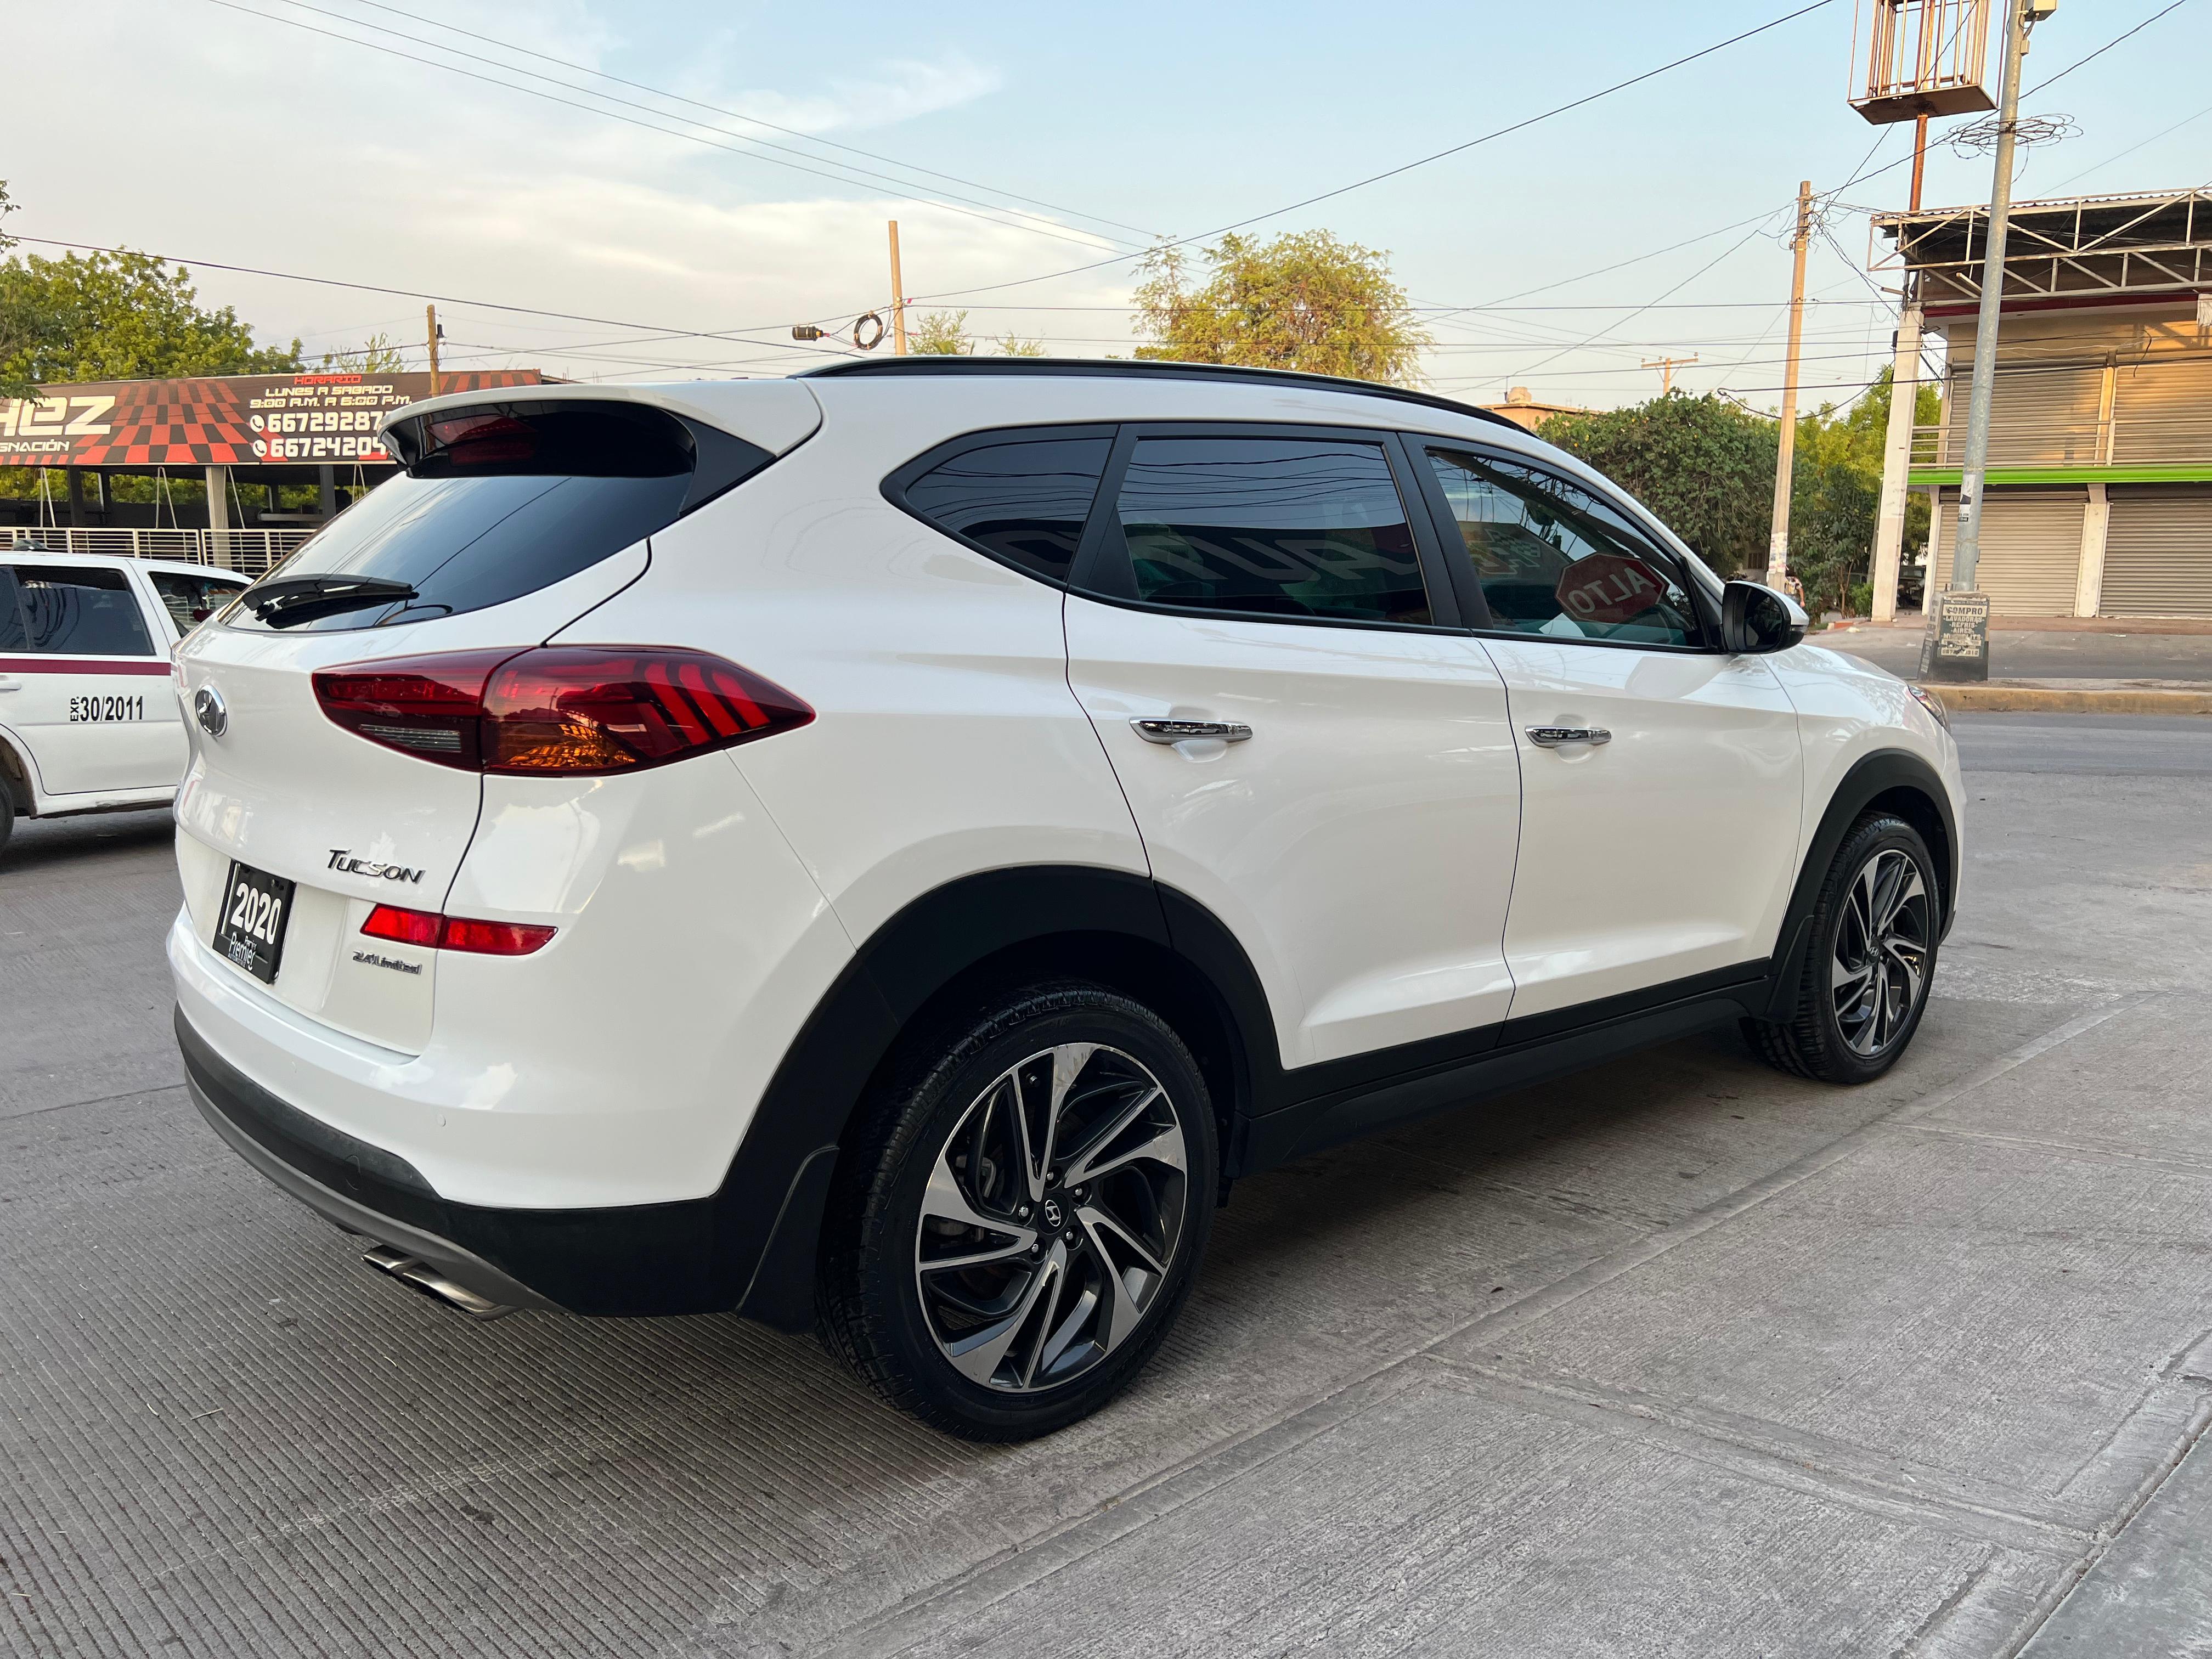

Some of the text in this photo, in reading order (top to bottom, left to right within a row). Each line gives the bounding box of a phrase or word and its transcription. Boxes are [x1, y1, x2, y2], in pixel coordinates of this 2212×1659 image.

[266, 385, 394, 397] LUNES A SABADO
[294, 375, 362, 385] HORARIO
[250, 398, 286, 409] 9:00
[289, 397, 320, 407] A.M.
[325, 397, 337, 406] A
[382, 395, 413, 405] P.M.
[268, 411, 392, 433] 66729287
[270, 436, 393, 458] 66724204
[70, 696, 79, 721] EXP.
[81, 696, 143, 721] 30/2011
[230, 882, 282, 945] 2020
